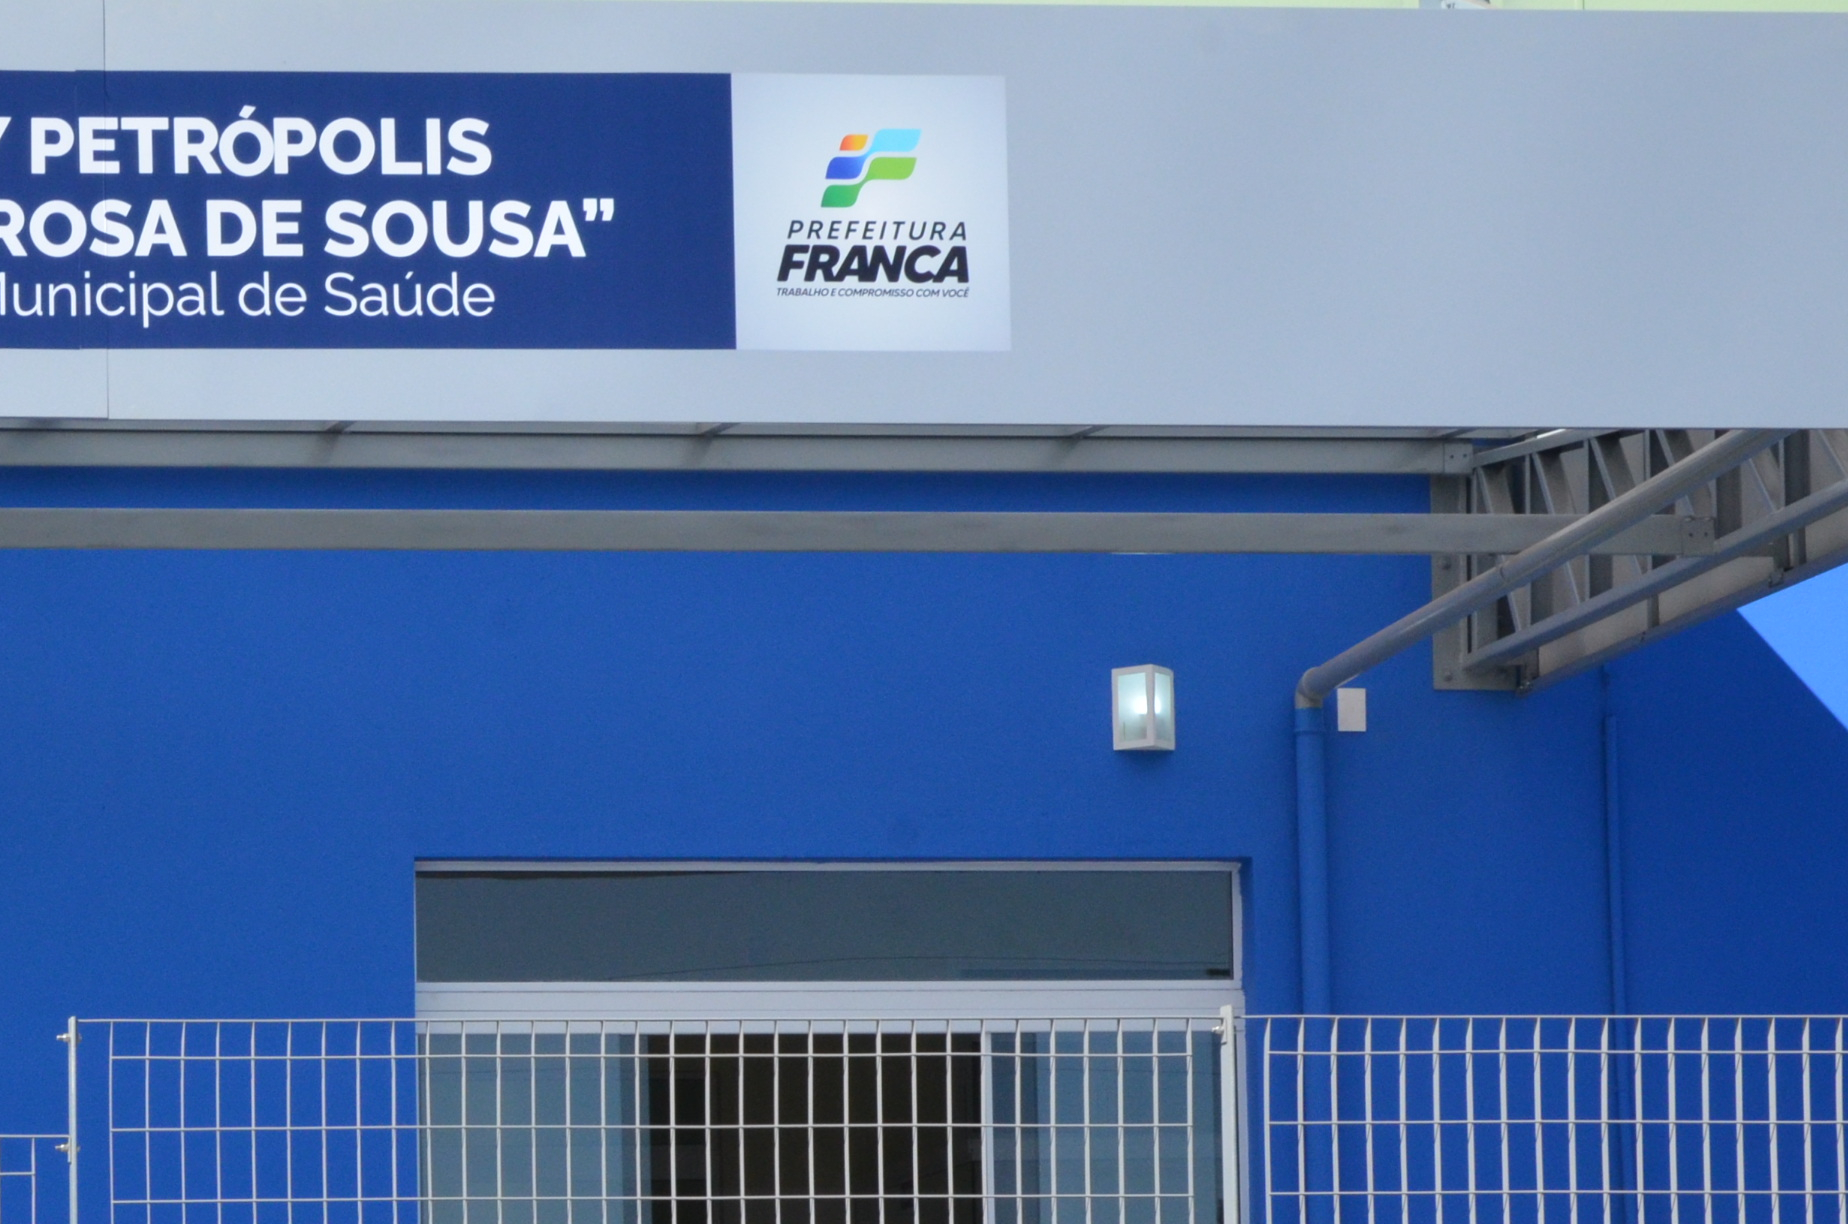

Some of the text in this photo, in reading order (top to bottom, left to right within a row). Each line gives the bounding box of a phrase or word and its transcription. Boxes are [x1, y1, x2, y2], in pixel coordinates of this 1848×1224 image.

[30, 104, 493, 177] PETRÓPOLIS
[205, 199, 304, 257] DE
[787, 219, 967, 241] PREFEITURA
[776, 243, 970, 284] FRANCA
[238, 270, 308, 317] de
[324, 270, 496, 318] Saúde
[776, 287, 829, 297] TRABALHO
[830, 287, 836, 297] E
[837, 287, 914, 297] COMPROMISSO
[915, 288, 940, 298] COM
